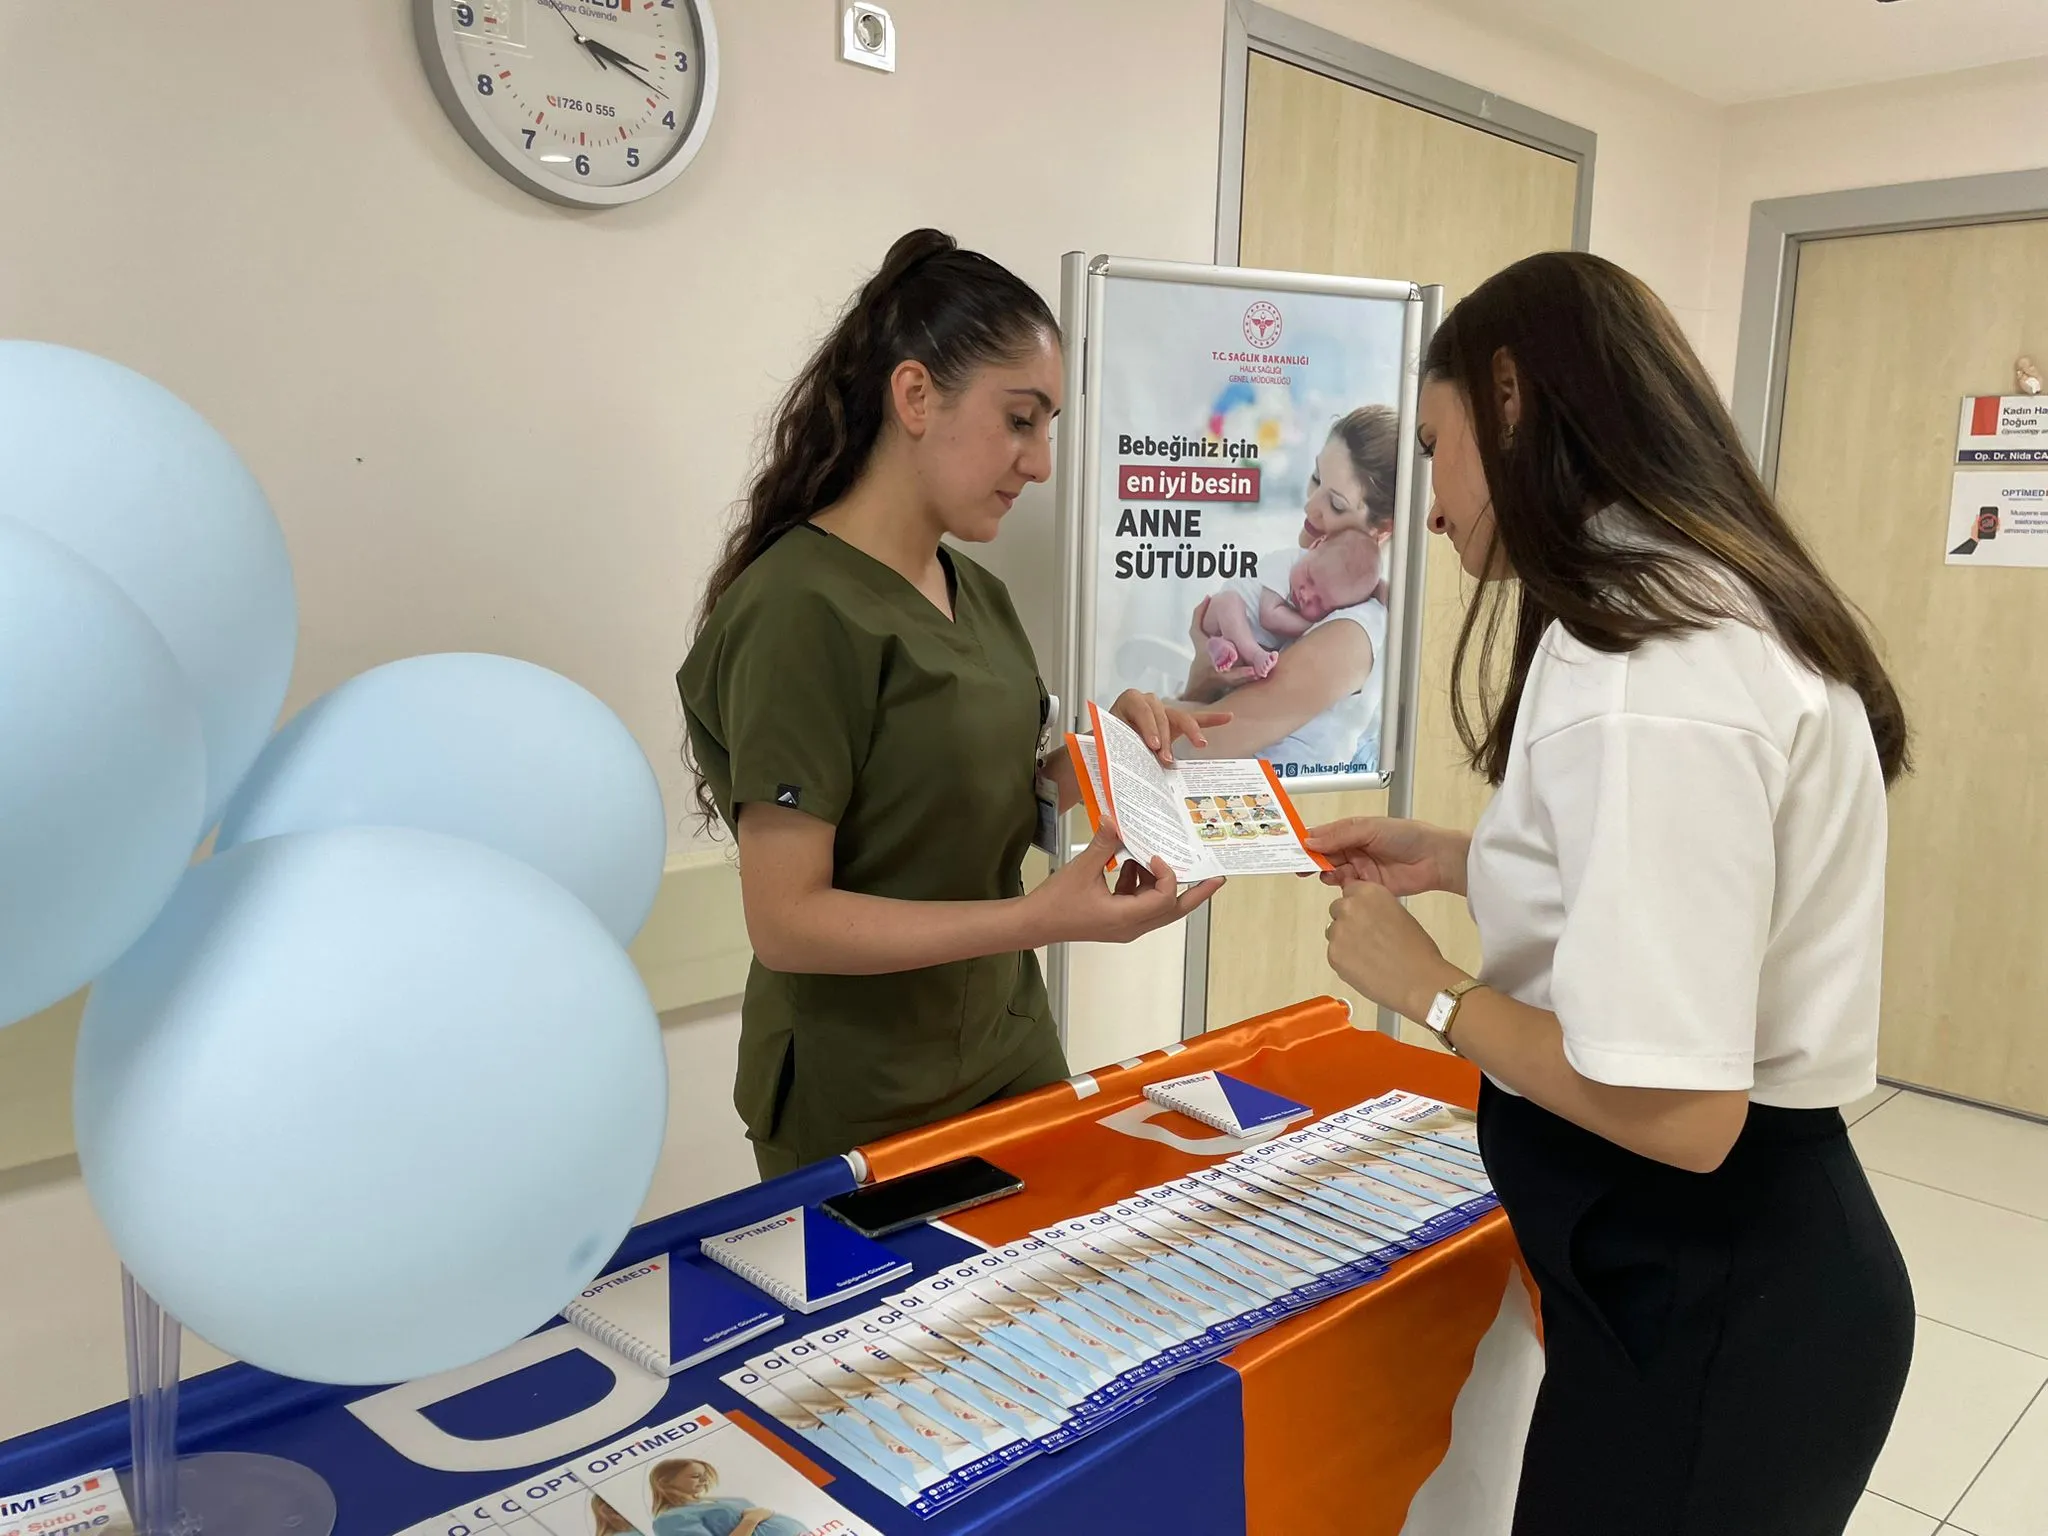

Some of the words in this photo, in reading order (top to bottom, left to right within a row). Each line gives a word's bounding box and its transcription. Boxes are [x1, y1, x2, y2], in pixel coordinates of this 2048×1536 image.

[457, 4, 474, 27] 9
[674, 52, 688, 72] 3
[477, 74, 494, 96] 8
[562, 98, 583, 111] 726
[586, 102, 592, 113] 0
[596, 104, 615, 117] 555
[662, 111, 676, 130] 4
[521, 129, 537, 149] 7
[575, 155, 590, 176] 6
[627, 148, 640, 168] 5
[1212, 351, 1226, 361] T.C.
[1228, 352, 1260, 362] SAĞLIK
[1262, 354, 1309, 366] BAKANLIĞI
[1229, 375, 1249, 383] GENEL
[1240, 365, 1256, 373] HALK
[2003, 407, 2032, 415] Kadın
[2002, 418, 2037, 428] Doğum
[1119, 434, 1218, 462] Bebeğiniz
[1223, 438, 1258, 463] için
[1975, 452, 1991, 461] Op.
[1994, 452, 2007, 460] Dr.
[2010, 451, 2031, 460] Nida
[1127, 475, 1154, 493] en
[1159, 471, 1186, 499] iyi
[1191, 473, 1251, 495] besin
[1115, 509, 1201, 537] ANNE
[1115, 544, 1258, 579] SÜTÜDÜR
